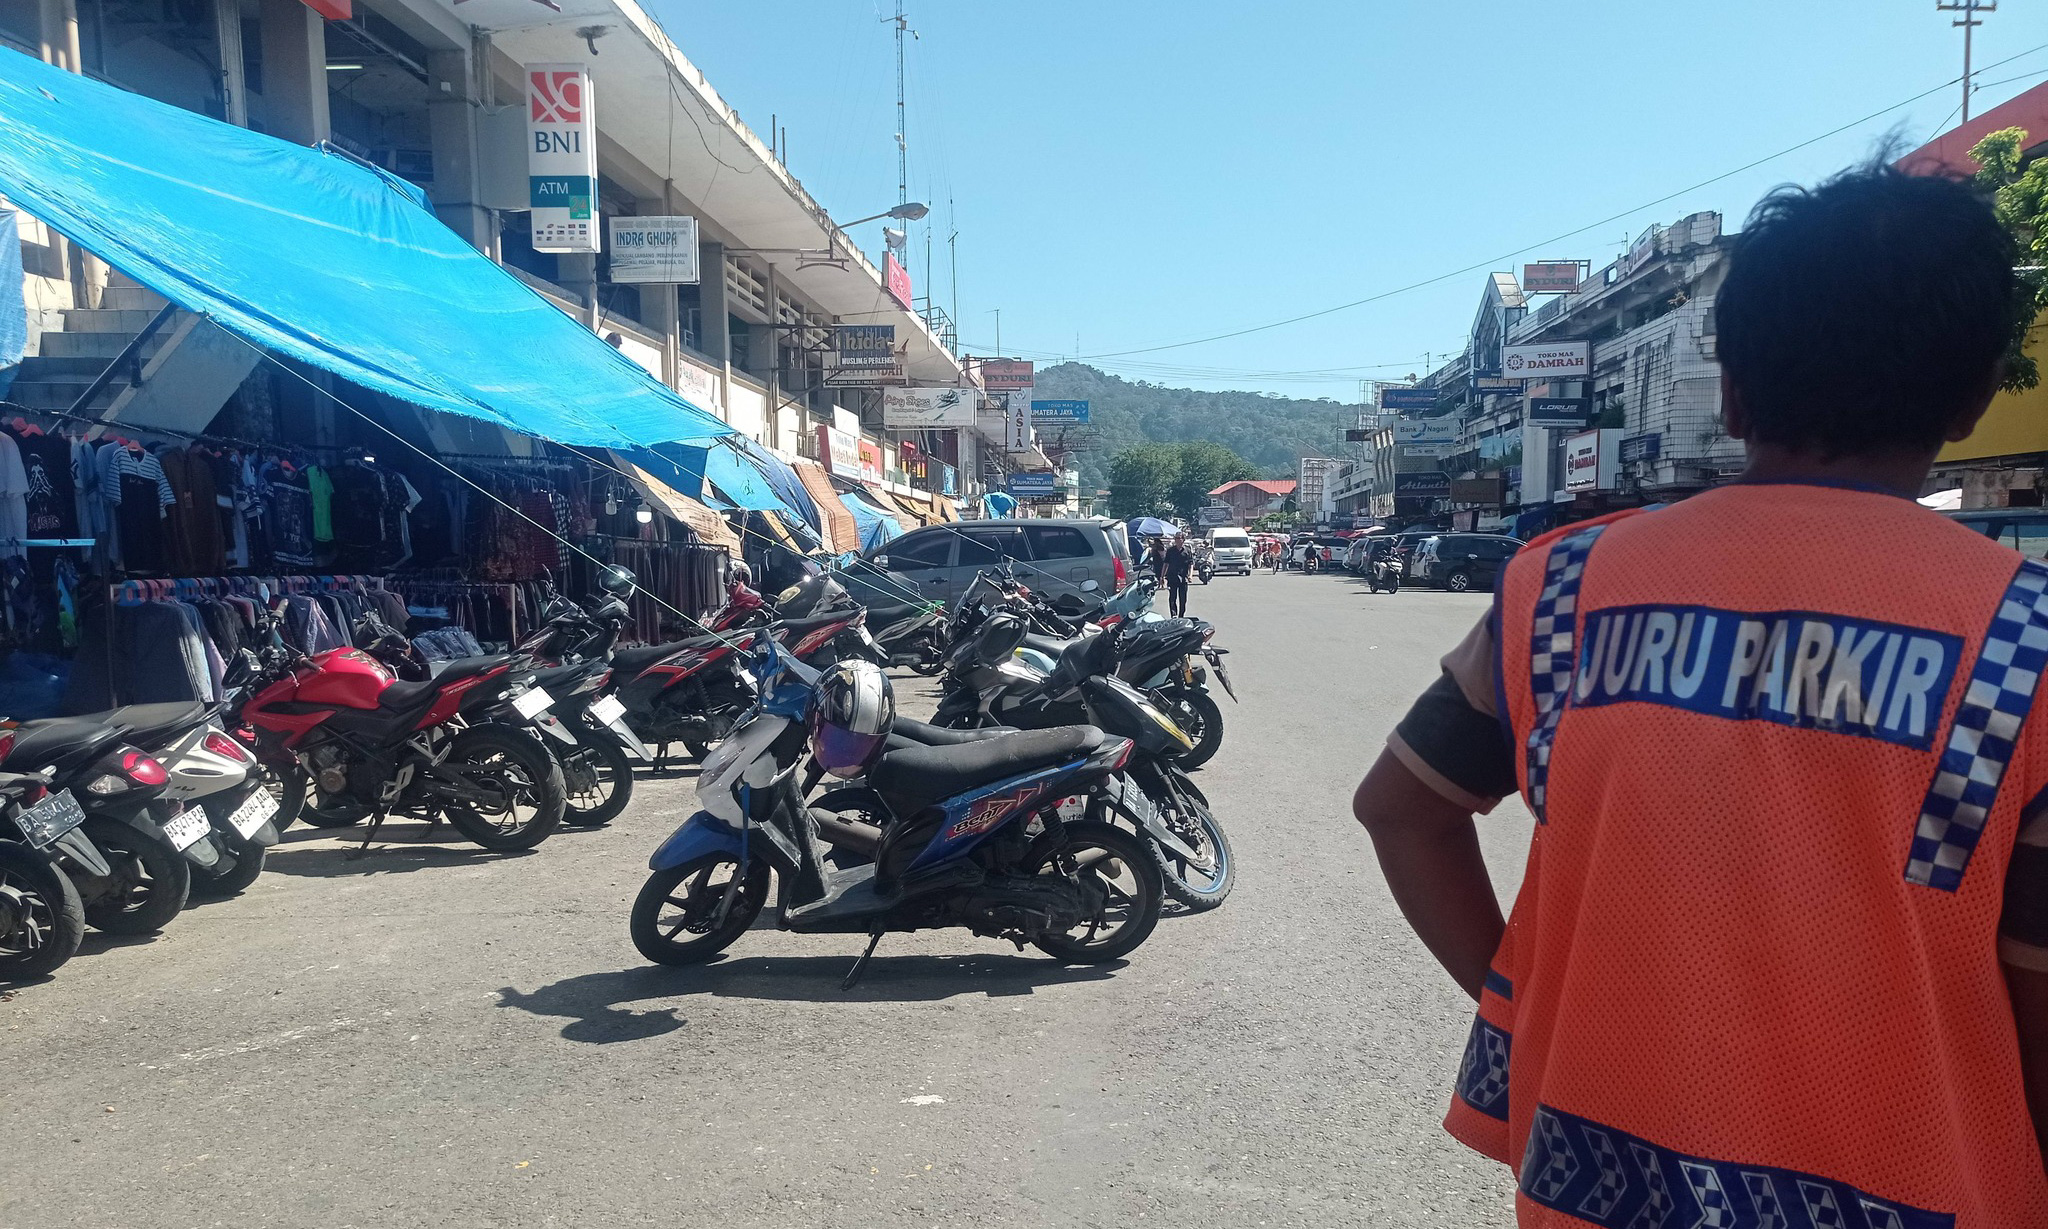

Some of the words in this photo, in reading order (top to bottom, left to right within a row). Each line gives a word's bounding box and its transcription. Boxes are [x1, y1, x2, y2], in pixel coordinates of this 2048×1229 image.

[535, 131, 581, 154] BNI
[538, 182, 569, 195] ATM
[571, 197, 587, 212] 24
[616, 231, 644, 246] INDRA
[1527, 357, 1584, 369] DAMRAH
[1015, 408, 1024, 447] ASIA
[1427, 425, 1449, 433] Nagari
[1575, 455, 1596, 470] DAMRAH
[1399, 480, 1450, 490] Atlantis
[1576, 609, 1718, 701] JURU
[1720, 621, 1950, 739] PARKIR
[19, 814, 41, 833] BA
